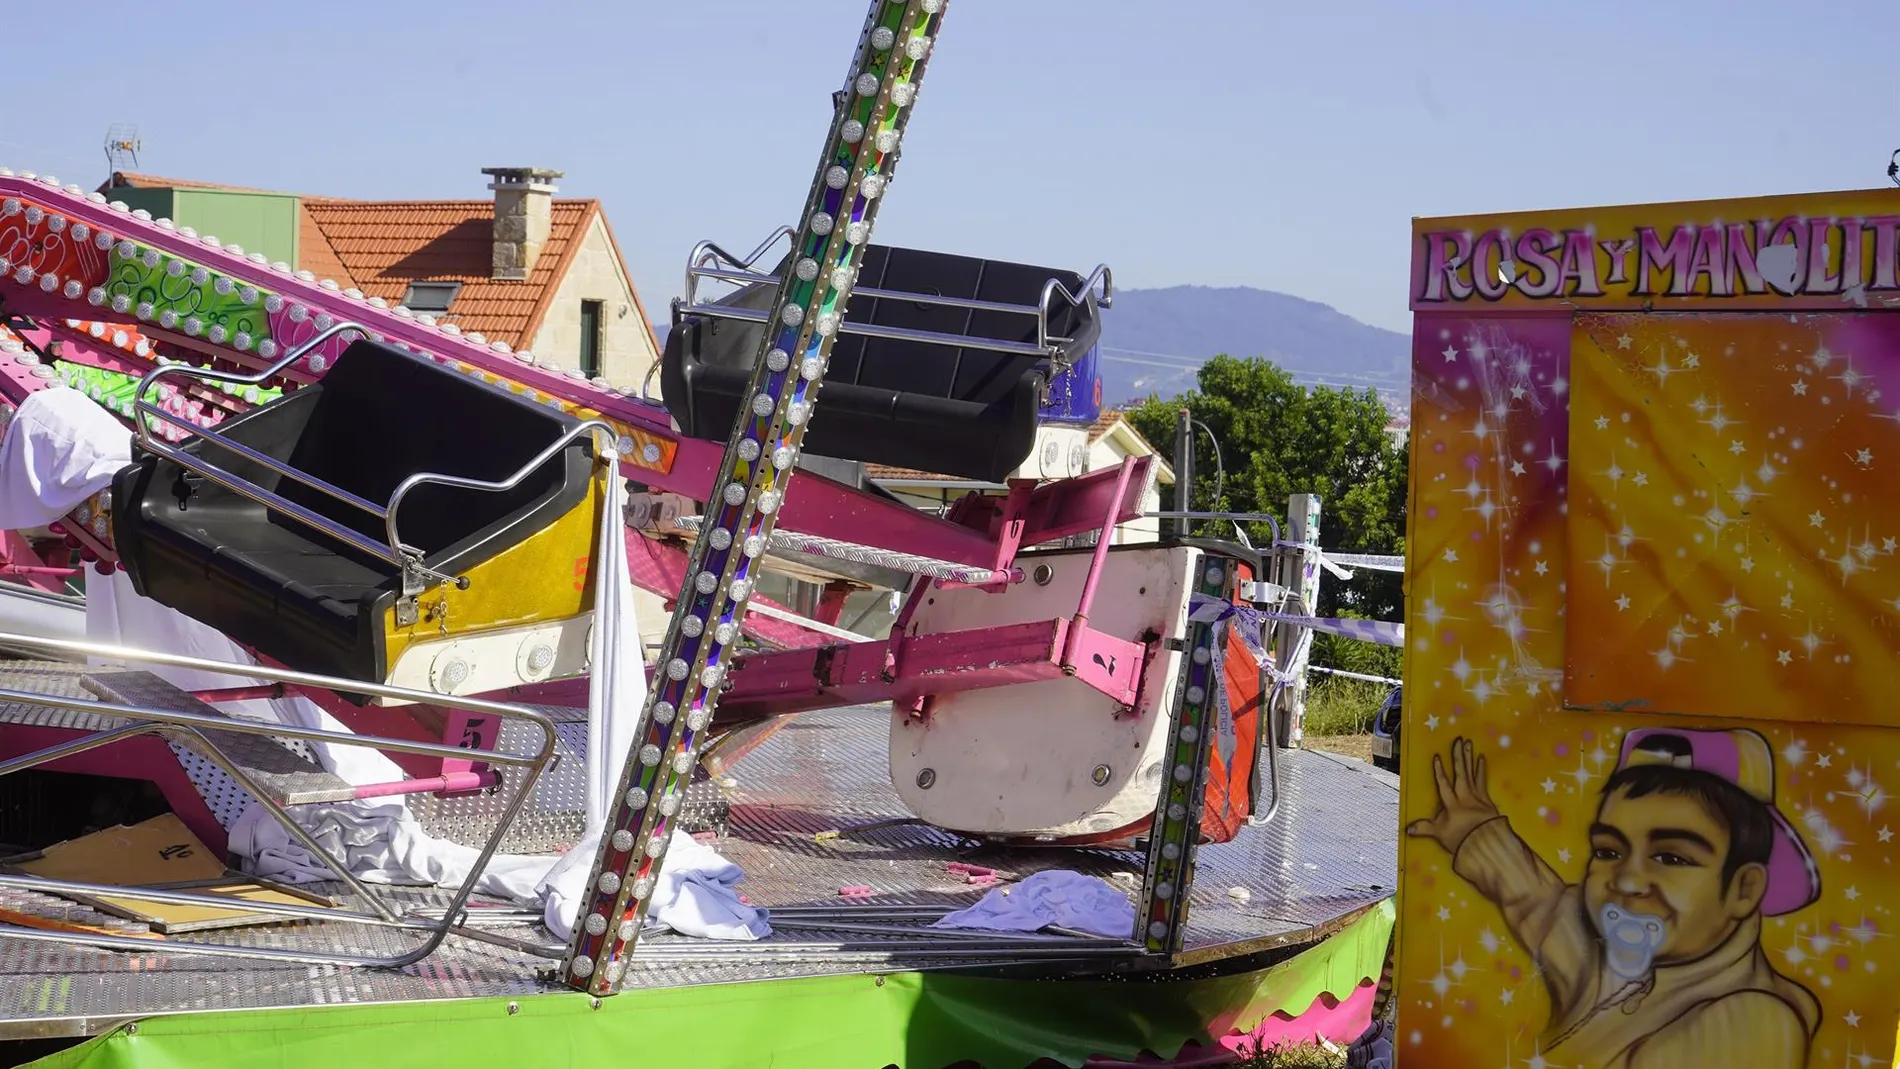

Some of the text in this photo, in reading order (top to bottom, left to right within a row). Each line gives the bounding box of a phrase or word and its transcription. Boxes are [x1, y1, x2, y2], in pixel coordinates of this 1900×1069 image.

[1417, 228, 1606, 303] ROSA
[1600, 239, 1635, 284] Y
[459, 718, 486, 749] 5
